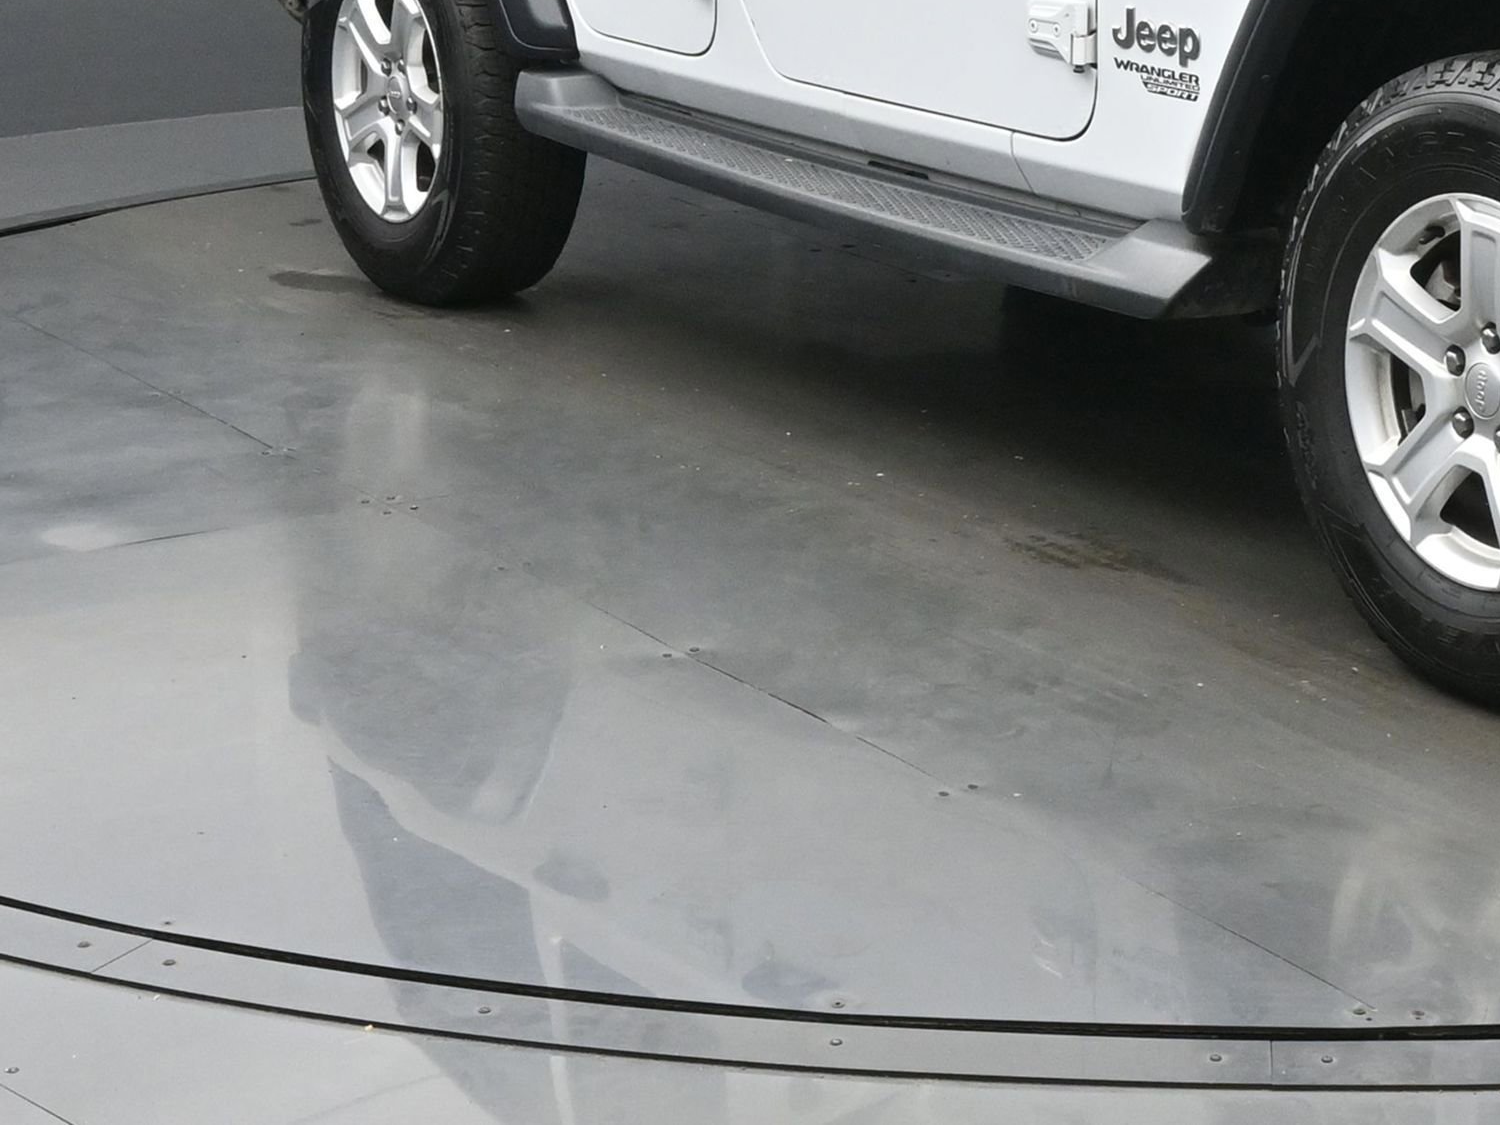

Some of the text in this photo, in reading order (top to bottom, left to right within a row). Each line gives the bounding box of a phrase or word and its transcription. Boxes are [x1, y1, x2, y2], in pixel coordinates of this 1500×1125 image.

[1112, 7, 1201, 68] Jeep
[1113, 57, 1200, 86] WRANGLER
[1140, 74, 1200, 92] UNLIMITED
